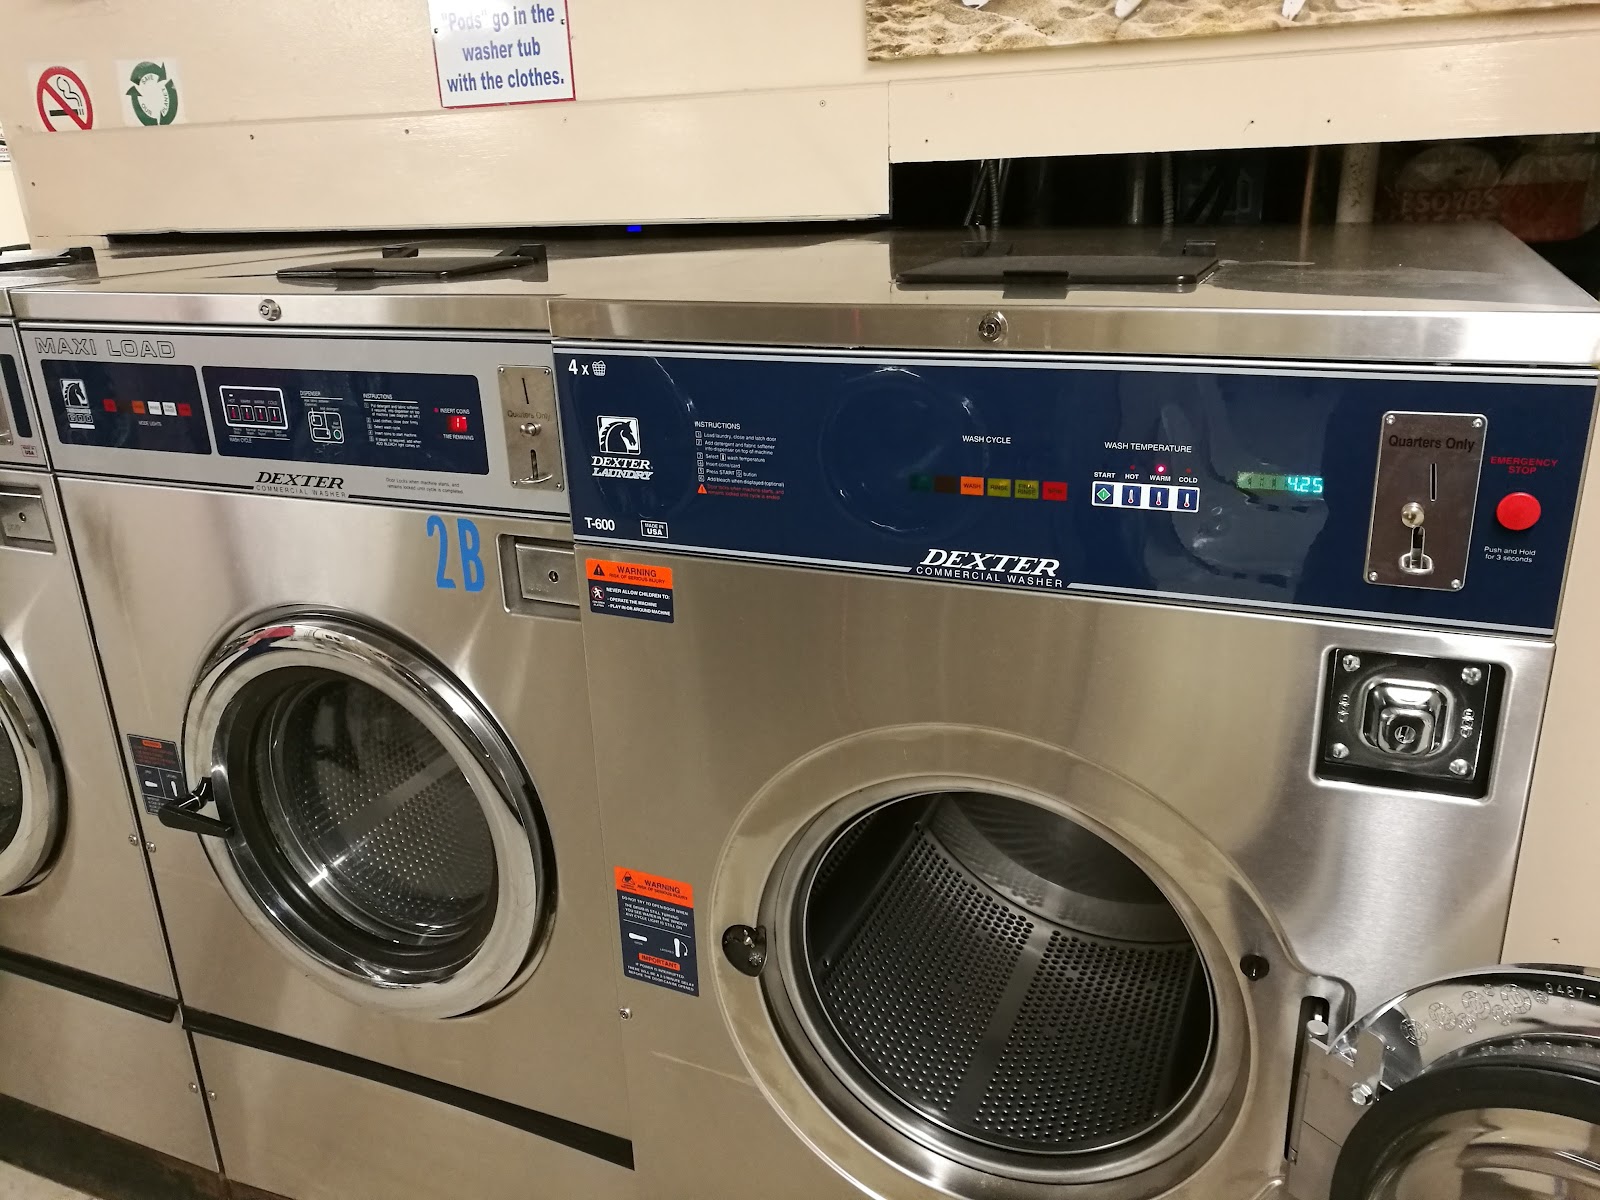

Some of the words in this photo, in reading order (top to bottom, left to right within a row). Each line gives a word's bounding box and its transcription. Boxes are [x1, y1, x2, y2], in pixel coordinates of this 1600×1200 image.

[493, 11, 509, 32] go
[513, 6, 526, 25] in
[531, 4, 555, 23] the
[462, 40, 513, 61] washer
[517, 37, 540, 57] tub
[447, 72, 477, 92] with
[480, 71, 503, 90] the
[508, 68, 564, 88] clothes.
[34, 337, 97, 355] MAXI
[106, 339, 175, 358] LOAD
[568, 359, 578, 375] 4
[581, 365, 589, 375] x
[536, 412, 551, 421] Only
[694, 421, 740, 430] INSTRUCTIONS
[962, 435, 985, 443] WASH
[986, 436, 1011, 444] CYCLE
[1388, 434, 1442, 449] Quarters
[1445, 437, 1475, 453] Only
[1105, 441, 1129, 450] WASH
[1131, 442, 1192, 453] TEMPERATURE
[591, 456, 652, 470] DEXTER
[1490, 456, 1558, 467] EMERGENCY
[592, 467, 654, 480] LAUNDRY
[1093, 471, 1116, 479] START
[1508, 466, 1537, 475] STOP
[255, 471, 344, 489] DEXTER
[1178, 476, 1198, 484] COLD
[1287, 476, 1323, 493] 4.25
[256, 485, 308, 495] COMMERCIAL
[312, 489, 346, 498] WASHER
[584, 516, 615, 531] T-600
[647, 528, 663, 536] USA
[1484, 546, 1502, 554] Push
[1519, 548, 1536, 556] Hold
[920, 548, 1060, 577] DEXTER
[1503, 555, 1533, 563] seconds
[617, 566, 657, 577] WARNING
[916, 566, 1001, 582] COMMERCIAL
[1007, 574, 1063, 588] WASHER
[622, 588, 638, 596] ALLOW
[639, 590, 662, 599] CHILDREN
[644, 880, 681, 894] WARNING
[650, 908, 661, 916] STILL
[652, 902, 662, 910] OPEN
[663, 905, 676, 913] DOOR
[676, 908, 689, 916] WHEN
[665, 921, 675, 929] STILL
[641, 954, 678, 969] IMPORTANT
